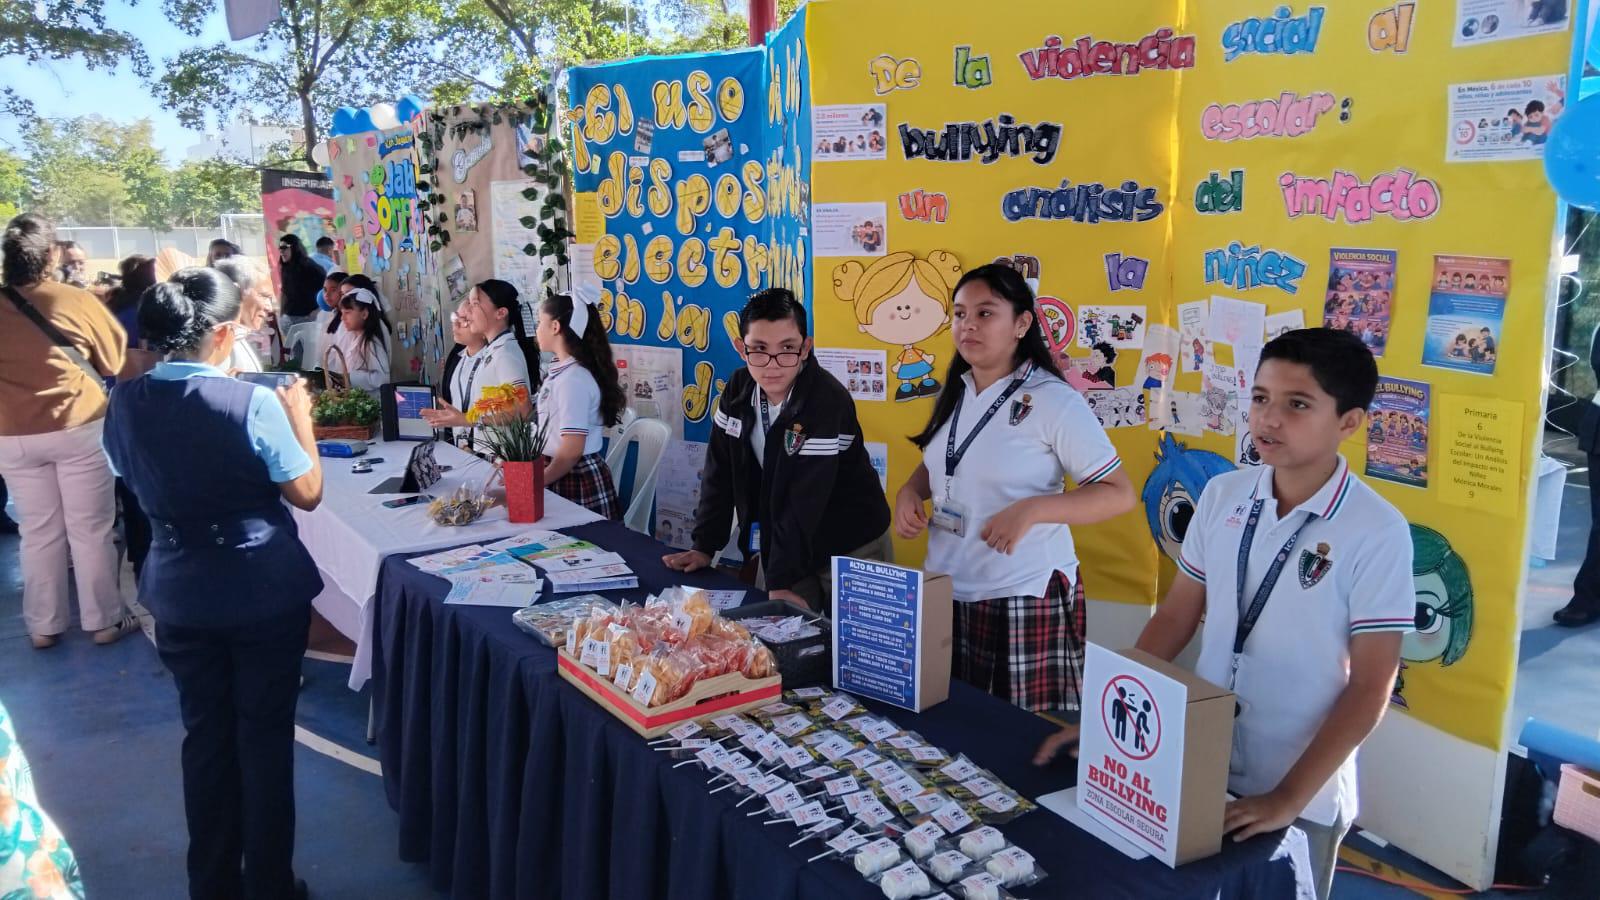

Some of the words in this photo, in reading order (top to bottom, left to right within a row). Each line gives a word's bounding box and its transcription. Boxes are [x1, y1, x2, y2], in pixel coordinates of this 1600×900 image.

[870, 55, 921, 94] De
[955, 46, 991, 88] la
[1019, 29, 1196, 80] violencia
[1222, 6, 1324, 61] social
[1368, 3, 1415, 52] al
[652, 70, 744, 133] uso
[898, 114, 1063, 165] bullying
[899, 190, 949, 223] un
[1002, 179, 1163, 223] análisis
[1195, 170, 1245, 214] del
[1279, 169, 1439, 223] impacto
[1104, 252, 1148, 291] la
[1204, 240, 1309, 294] niñez
[1334, 252, 1367, 261] VIOLENCIA
[1367, 253, 1392, 263] SOCIAL
[657, 290, 712, 353] la
[1385, 383, 1425, 399] BULLYING
[1464, 407, 1498, 420] Primaria
[1477, 422, 1483, 431] 6
[849, 561, 865, 571] ALTO
[866, 564, 875, 573] AL
[875, 566, 907, 579] BULLYING
[1088, 764, 1168, 824] BULLYING
[1103, 754, 1128, 781] NO
[1131, 770, 1153, 796] AL
[1086, 788, 1104, 807] ZONA
[1105, 799, 1135, 828] ESCOLAR
[1136, 817, 1165, 844] SEGURA
